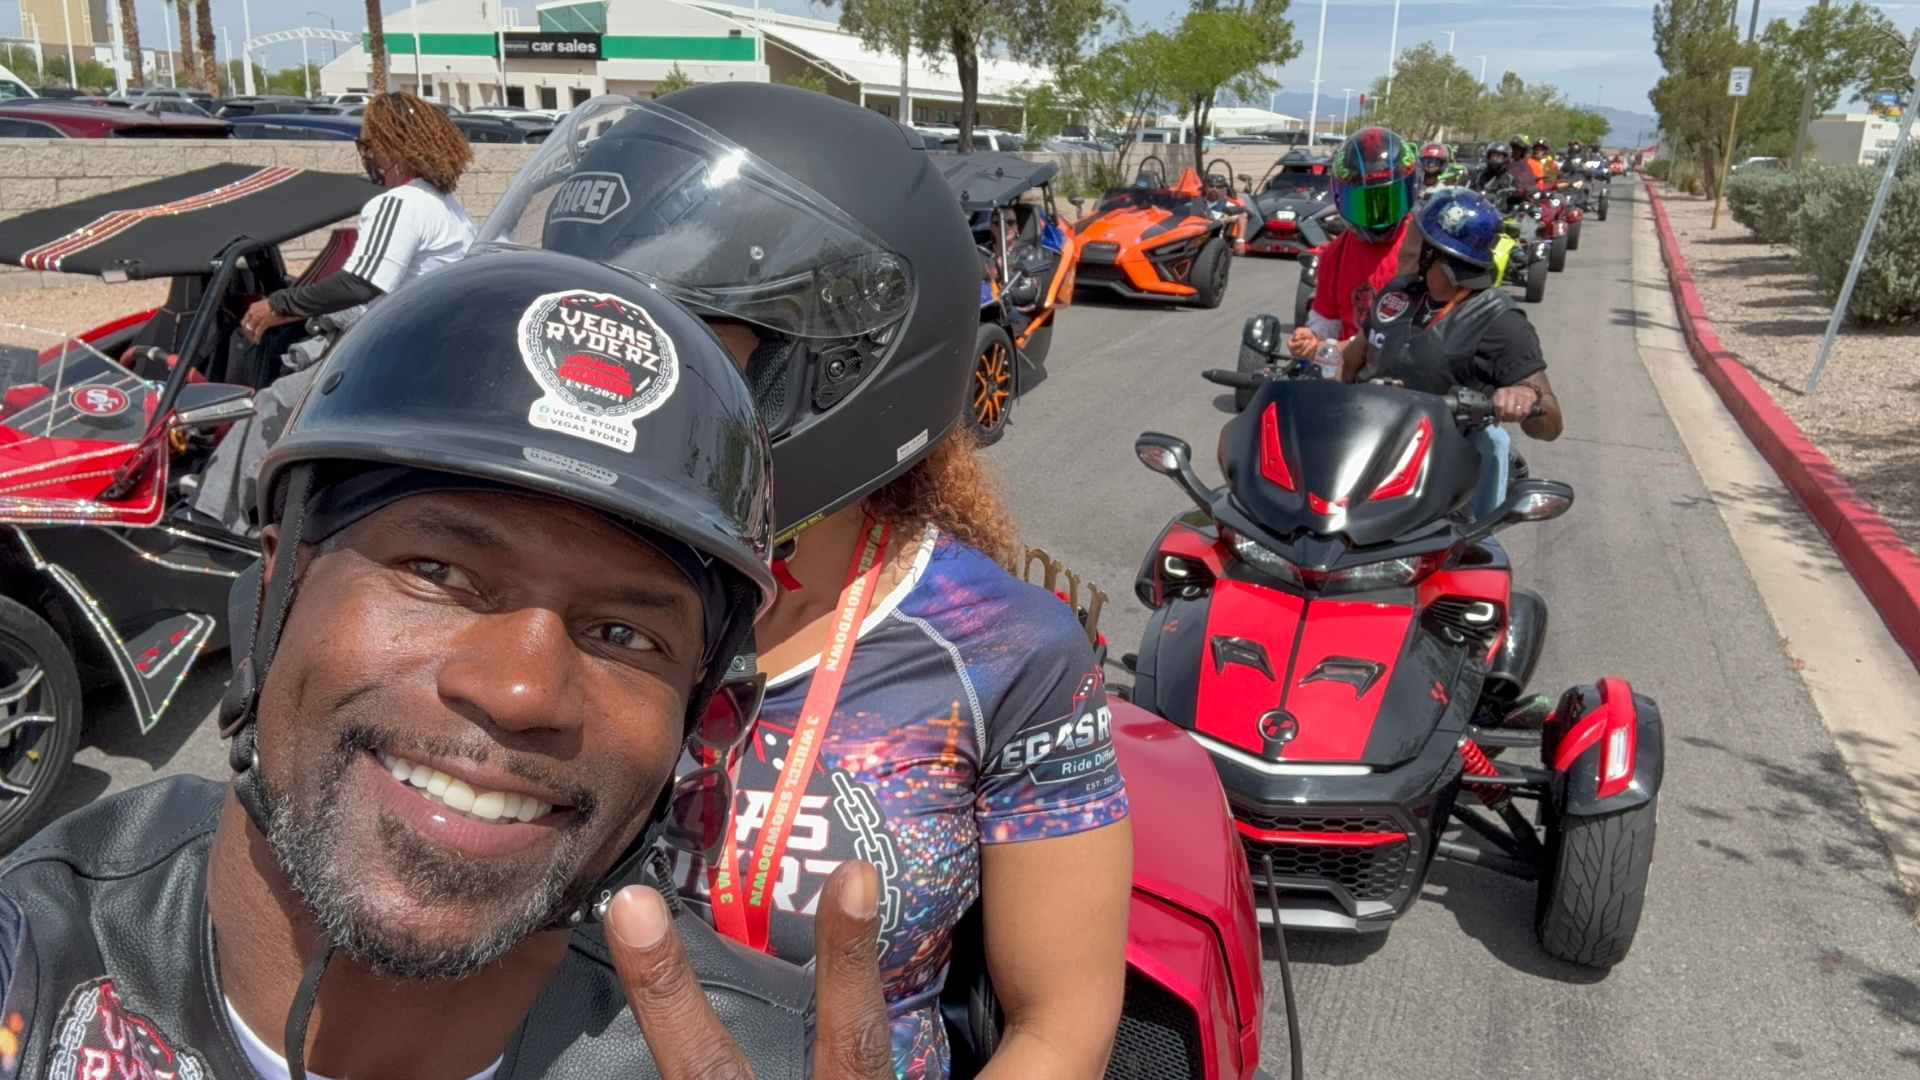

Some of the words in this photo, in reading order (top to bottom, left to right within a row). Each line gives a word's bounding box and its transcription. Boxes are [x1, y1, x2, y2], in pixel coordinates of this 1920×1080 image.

[531, 41, 555, 52] car
[557, 38, 597, 53] sales
[1734, 81, 1742, 91] 5
[553, 180, 617, 215] SHOEI
[559, 306, 652, 350] VEGAS
[546, 321, 660, 372] RYDERZ
[550, 417, 586, 432] VEGAS
[589, 428, 628, 447] RYDERZ
[552, 408, 588, 423] VEGAS
[591, 418, 630, 438] RYDERZ
[824, 575, 867, 673] SHOWDOWN
[806, 715, 820, 726] 3
[784, 728, 817, 788] WHEEL
[1062, 758, 1092, 775] Ride
[749, 789, 793, 907] SHOWDOWN
[720, 892, 733, 904] 3
